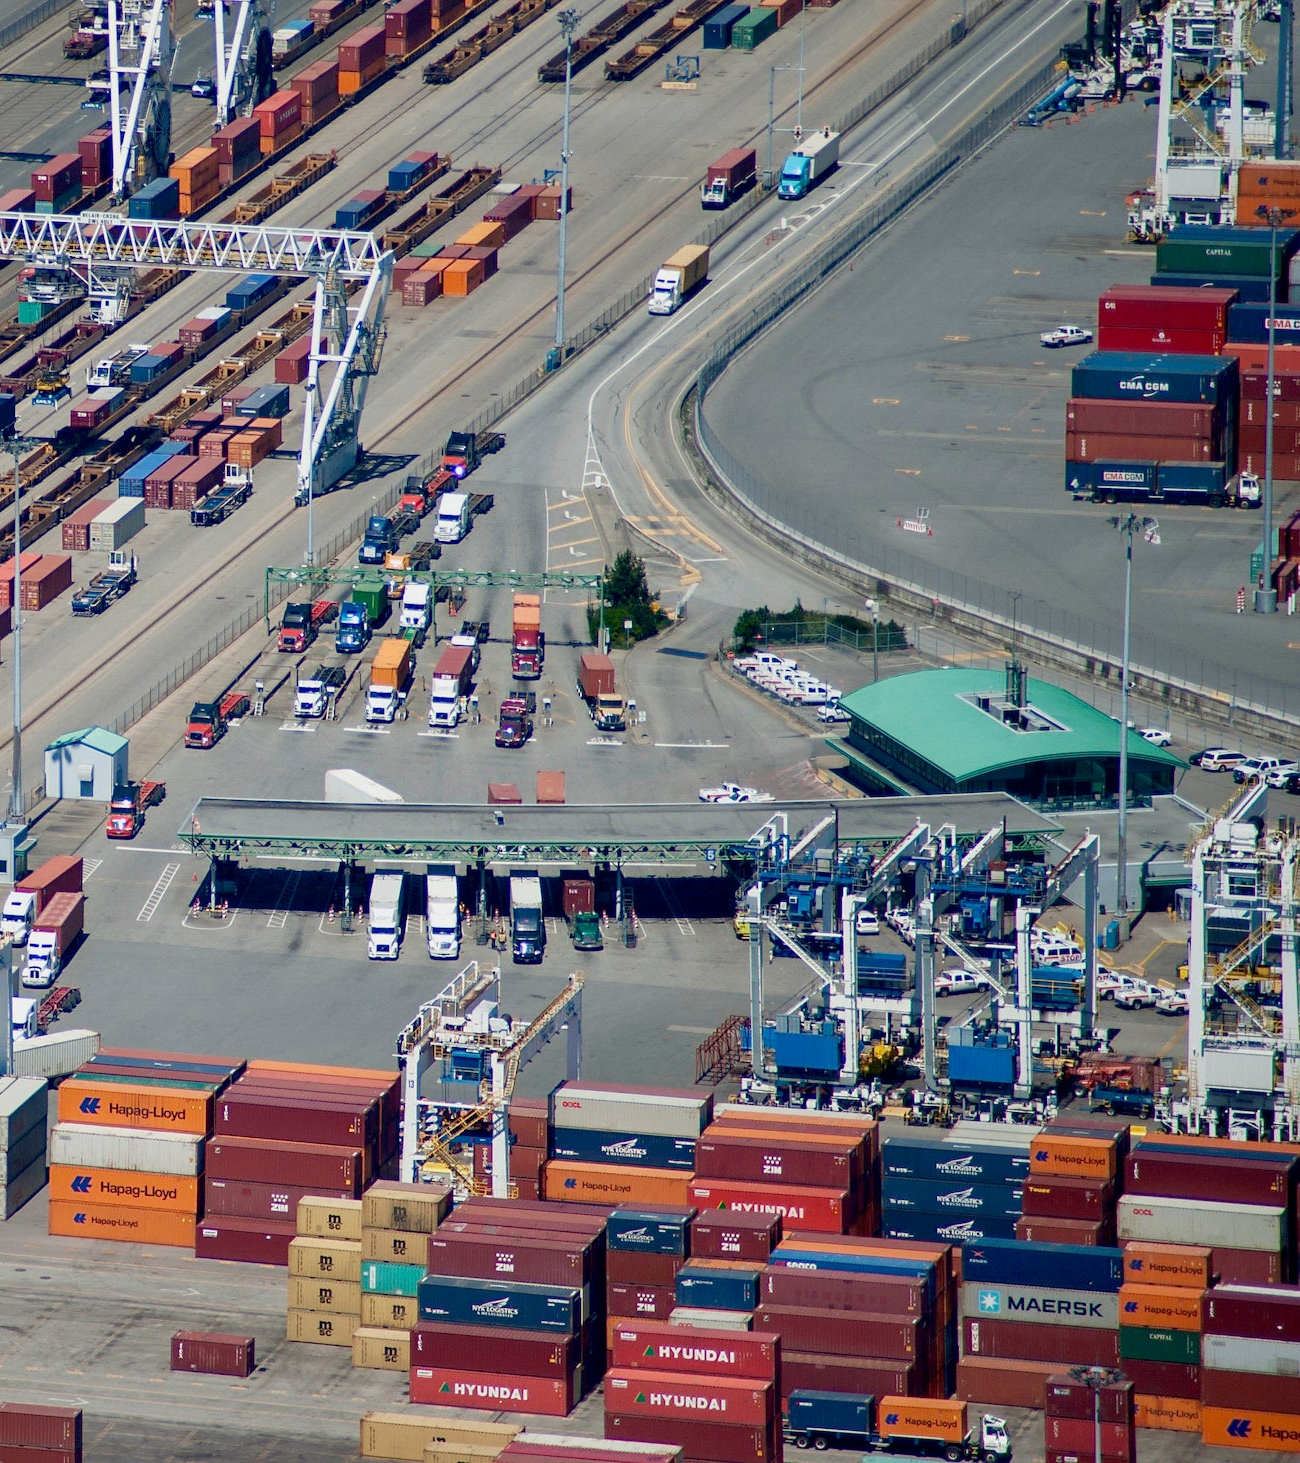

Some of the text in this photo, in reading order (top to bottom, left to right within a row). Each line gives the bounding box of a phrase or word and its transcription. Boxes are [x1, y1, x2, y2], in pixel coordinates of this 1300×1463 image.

[1206, 248, 1232, 256] CAPITAL
[1120, 381, 1169, 391] CMA CGM
[1104, 472, 1143, 482] CMA CGM
[707, 850, 715, 859] 5
[1061, 954, 1080, 962] STOP
[408, 1080, 415, 1088] 13
[109, 1102, 186, 1121] Hapag-Lloyd
[615, 1147, 647, 1156] LOGISTICS
[1054, 1154, 1105, 1166] Hapag-Lloyd
[763, 1165, 782, 1175] ZIM
[950, 1164, 983, 1173] LOGISTICS
[100, 1181, 177, 1201] Hapag-Lloyd
[582, 1181, 631, 1193] Hapag-Lloyd
[950, 1196, 983, 1205] LOGISTICS
[271, 1203, 289, 1213] ZIM
[91, 1216, 139, 1229] Hapag-Lloyd
[951, 1229, 984, 1237] LOGISTICS
[721, 1242, 741, 1252] ZIM
[496, 1262, 515, 1272] ZIM
[1150, 1263, 1203, 1275] Hapag-Lloyd
[486, 1306, 519, 1315] LOGISTICS
[637, 1303, 656, 1312] ZIM
[1007, 1296, 1103, 1318] MAERSK
[1144, 1305, 1198, 1317] Hapag-Lloyd
[1149, 1333, 1172, 1341] CAPITAL
[659, 1345, 735, 1364] HYUNDAI
[454, 1383, 528, 1401] HYUNDAI
[650, 1393, 726, 1411] HYUNDAI
[1145, 1407, 1199, 1420] Hapag-Lloyd
[905, 1417, 958, 1429] Hapag-Lloyd
[1261, 1425, 1300, 1443] Hapa
